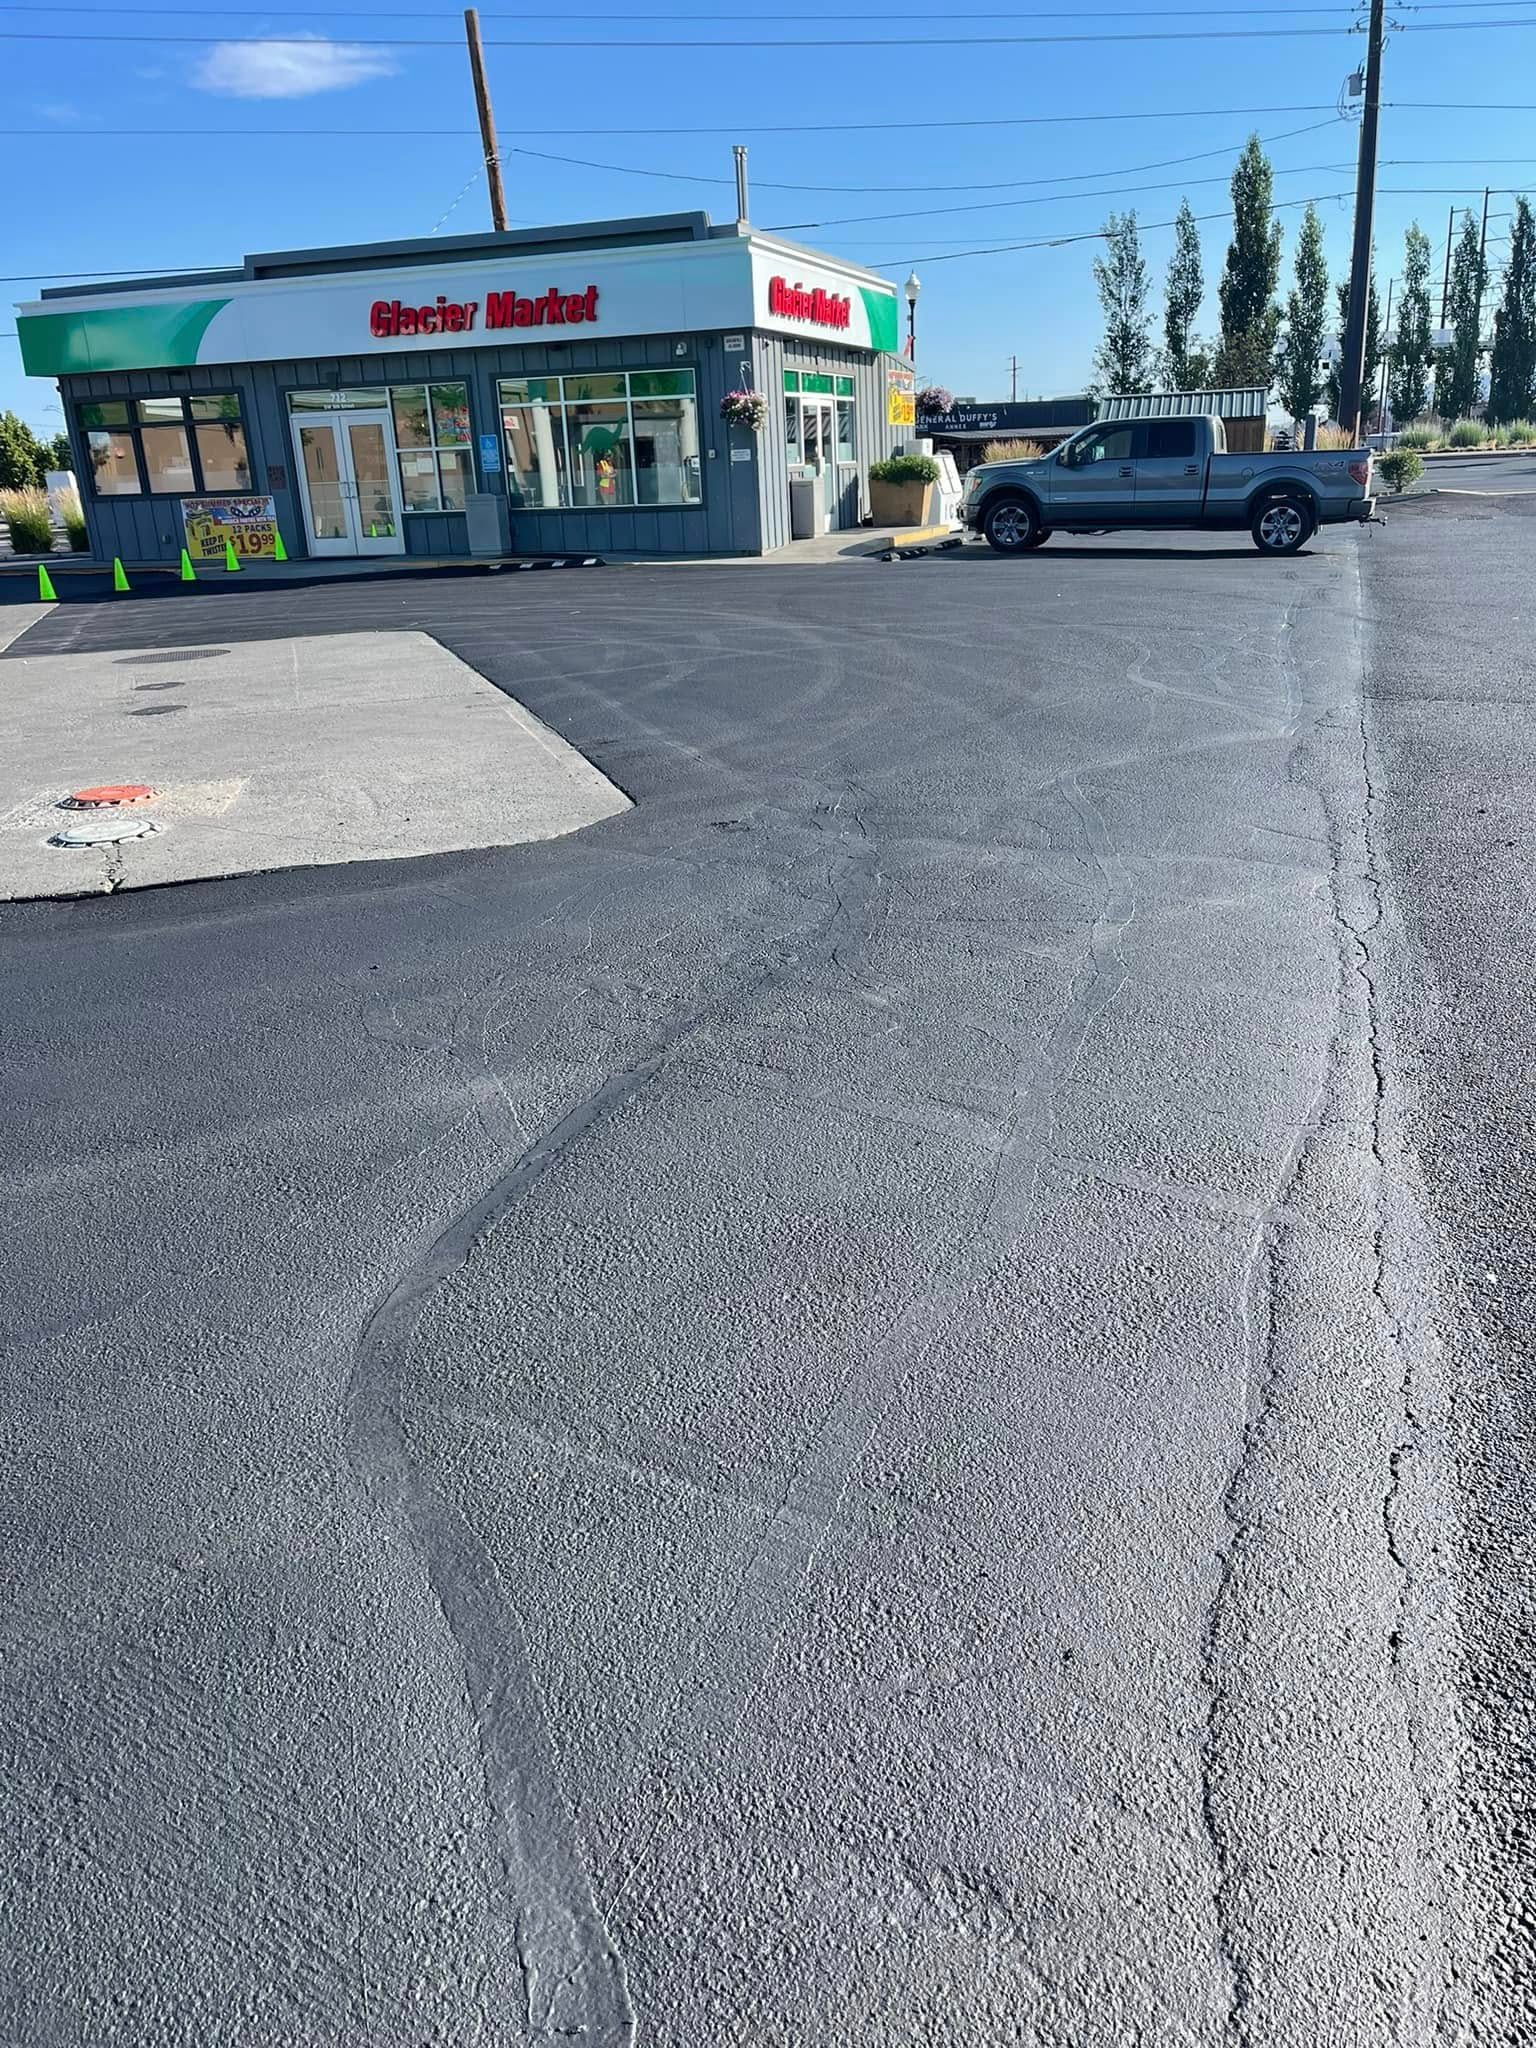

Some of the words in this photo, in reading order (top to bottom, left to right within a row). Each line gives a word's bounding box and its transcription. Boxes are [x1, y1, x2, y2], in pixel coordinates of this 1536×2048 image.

[768, 276, 814, 321] Glacier
[811, 288, 850, 331] Market
[370, 296, 478, 337] Glacier
[485, 285, 598, 329] Market
[959, 413, 998, 423] DUFFY'S
[232, 525, 241, 534] 12
[244, 523, 272, 533] PACKS
[201, 536, 217, 547] KEEP
